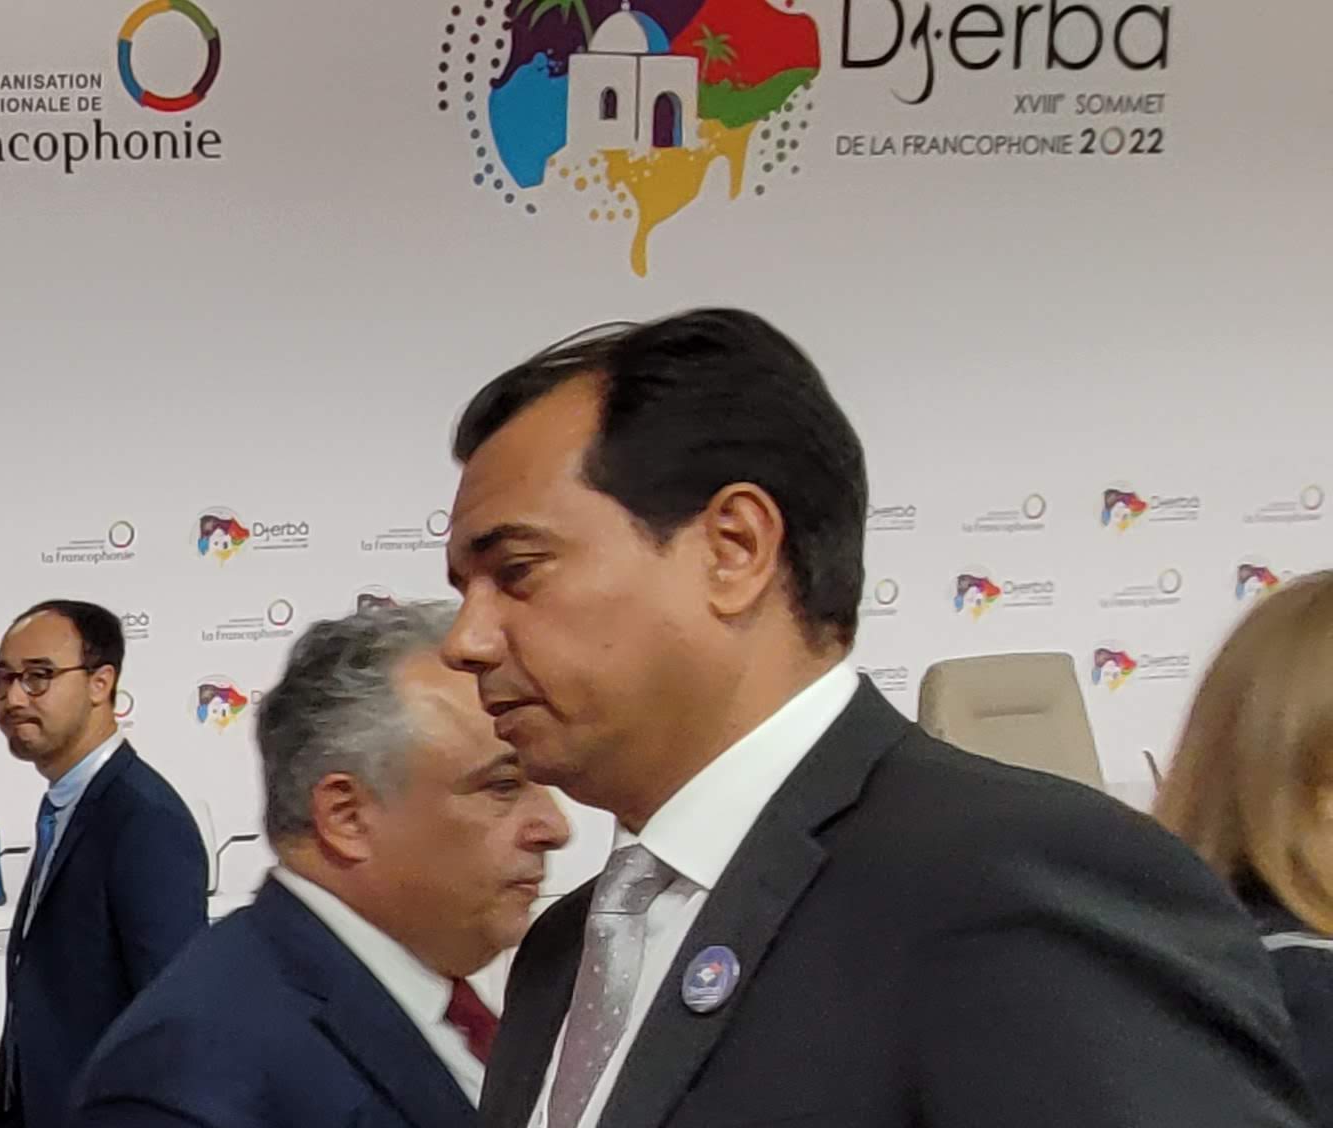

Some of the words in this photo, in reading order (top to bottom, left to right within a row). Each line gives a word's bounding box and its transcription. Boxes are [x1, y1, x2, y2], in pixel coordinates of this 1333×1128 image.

[78, 96, 103, 112] DE
[1075, 94, 1165, 115] SOMMET
[836, 135, 866, 156] DE
[870, 135, 896, 156] LA
[902, 134, 1073, 156] FRANCOPHONIE
[1079, 127, 1164, 155] 2022
